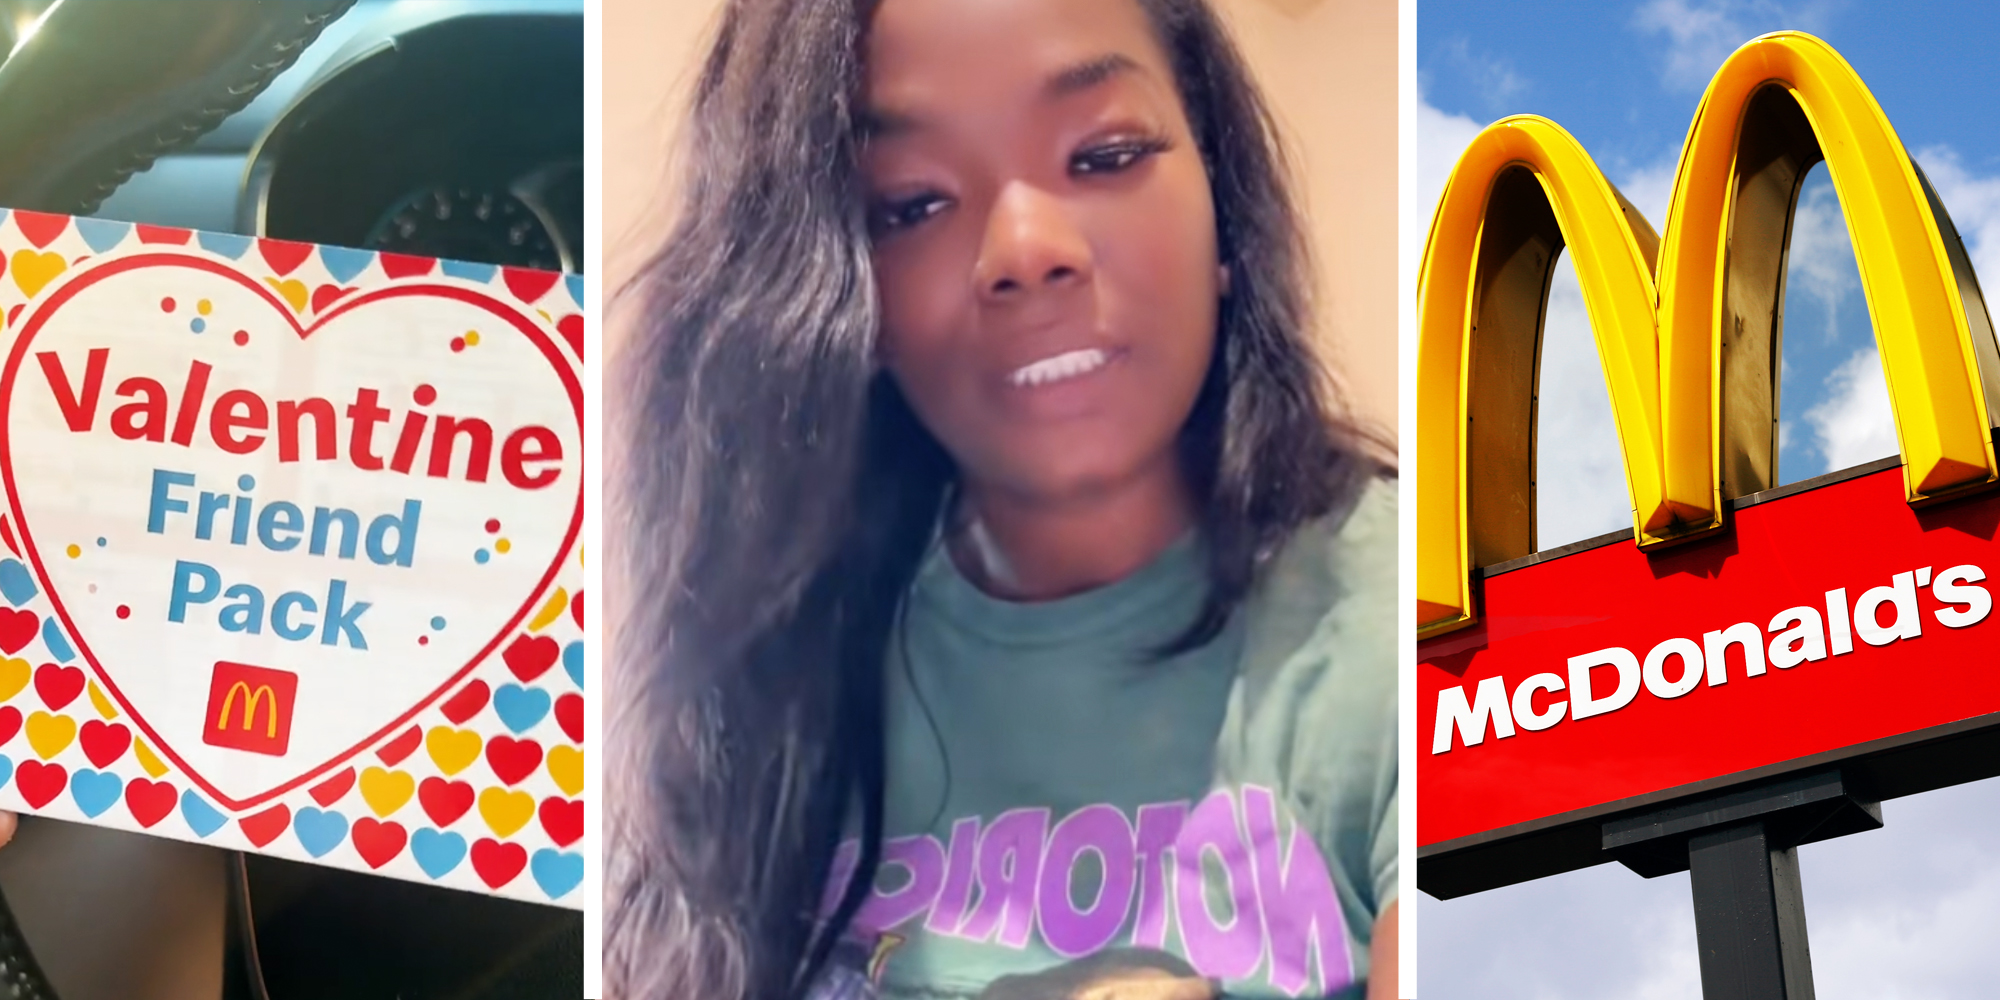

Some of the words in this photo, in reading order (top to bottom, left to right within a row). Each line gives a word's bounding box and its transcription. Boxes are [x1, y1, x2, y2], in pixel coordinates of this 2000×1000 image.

[36, 348, 563, 490] Valentine
[147, 469, 422, 568] Friend
[168, 560, 373, 651] Pack
[1432, 564, 1992, 755] McDonald's
